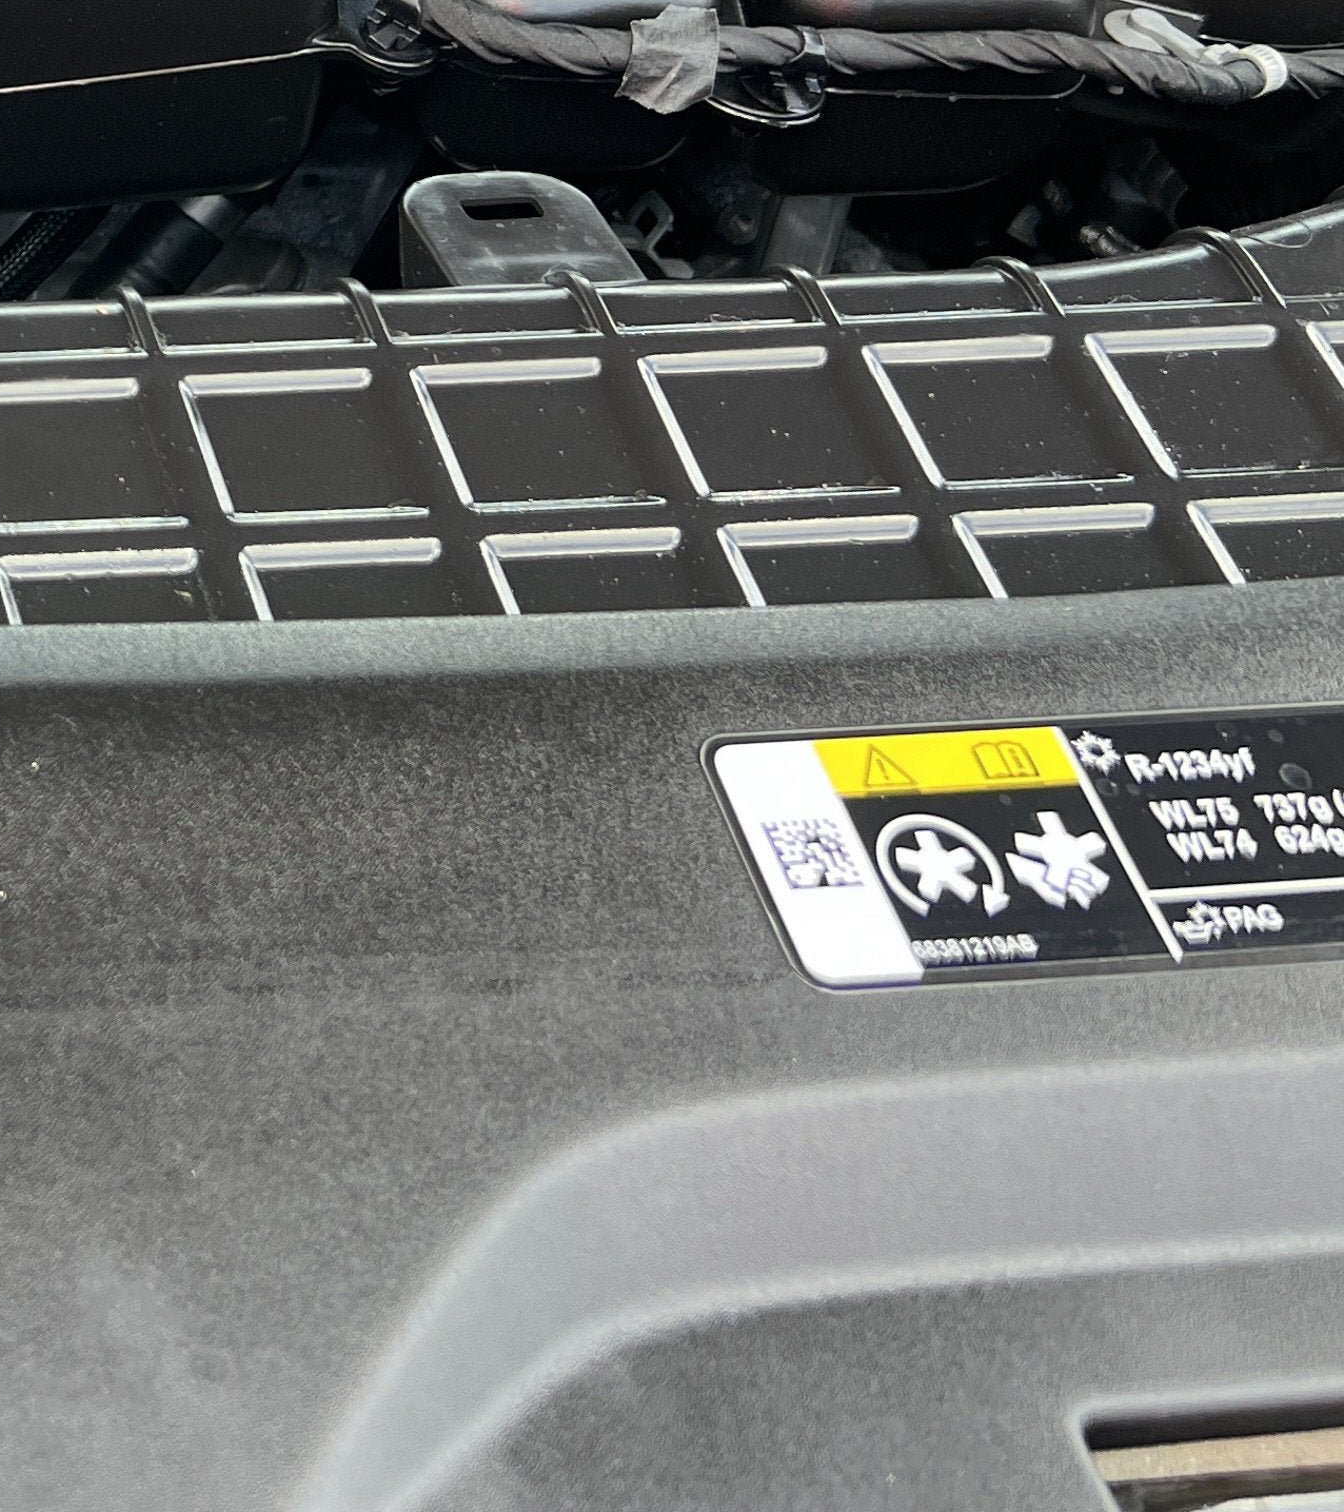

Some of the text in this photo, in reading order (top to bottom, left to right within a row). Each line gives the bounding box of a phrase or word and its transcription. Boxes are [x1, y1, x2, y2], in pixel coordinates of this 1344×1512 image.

[1124, 746, 1256, 784] R-1234yf
[1148, 797, 1240, 832] WL75
[1253, 791, 1334, 826] 737g
[1166, 827, 1258, 864] WL74
[1221, 903, 1285, 935] PAG
